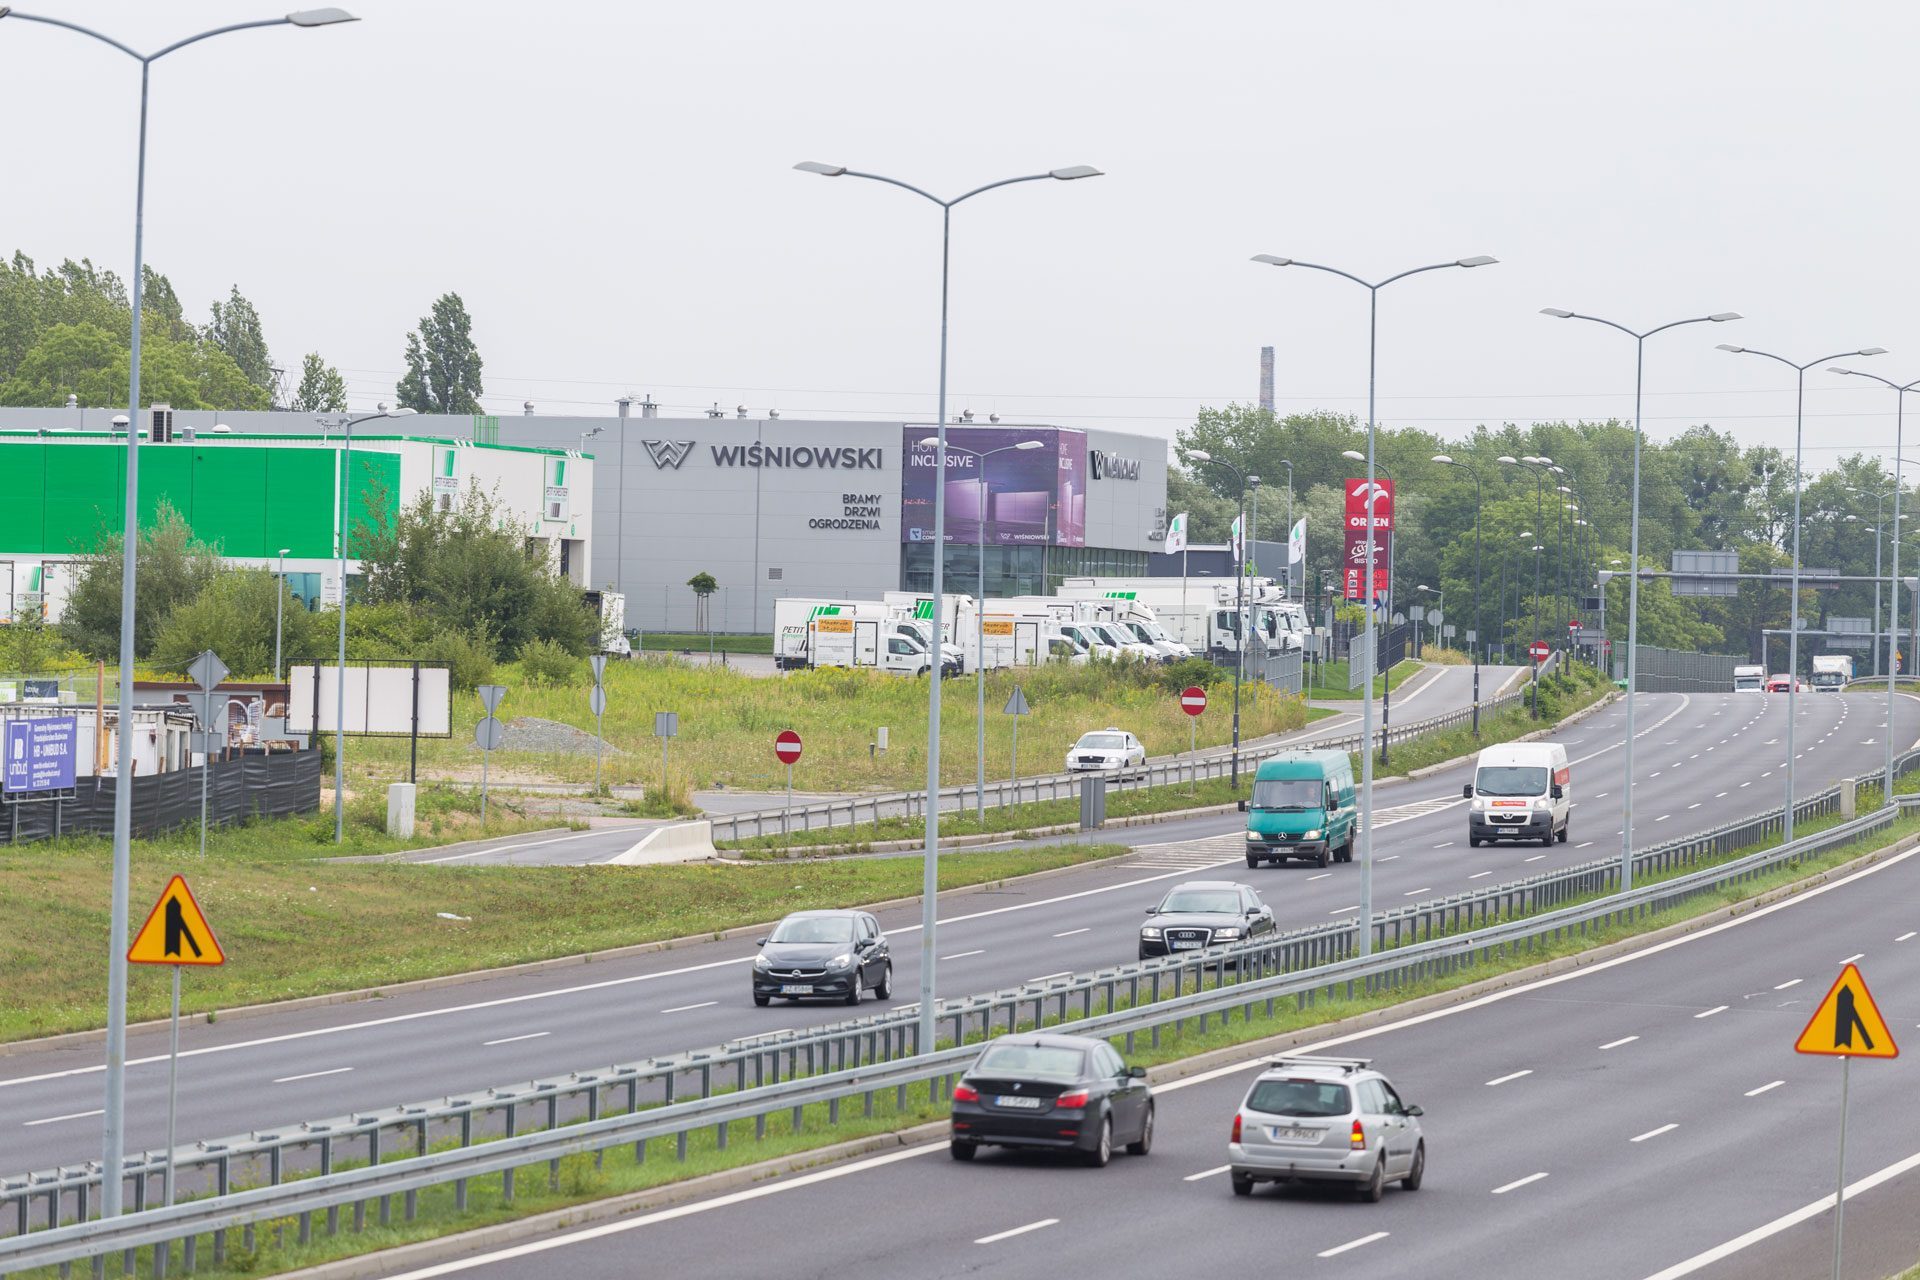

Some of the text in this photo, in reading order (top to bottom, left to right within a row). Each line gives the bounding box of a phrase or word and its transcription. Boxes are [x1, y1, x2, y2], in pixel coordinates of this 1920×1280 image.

[711, 441, 882, 469] WIŚNIOWSKI
[843, 494, 881, 504] BRAMY
[844, 506, 881, 517] DRZWI
[808, 518, 881, 530] OGRODZENIA
[1350, 517, 1389, 527] OREN
[783, 626, 804, 634] PETIT
